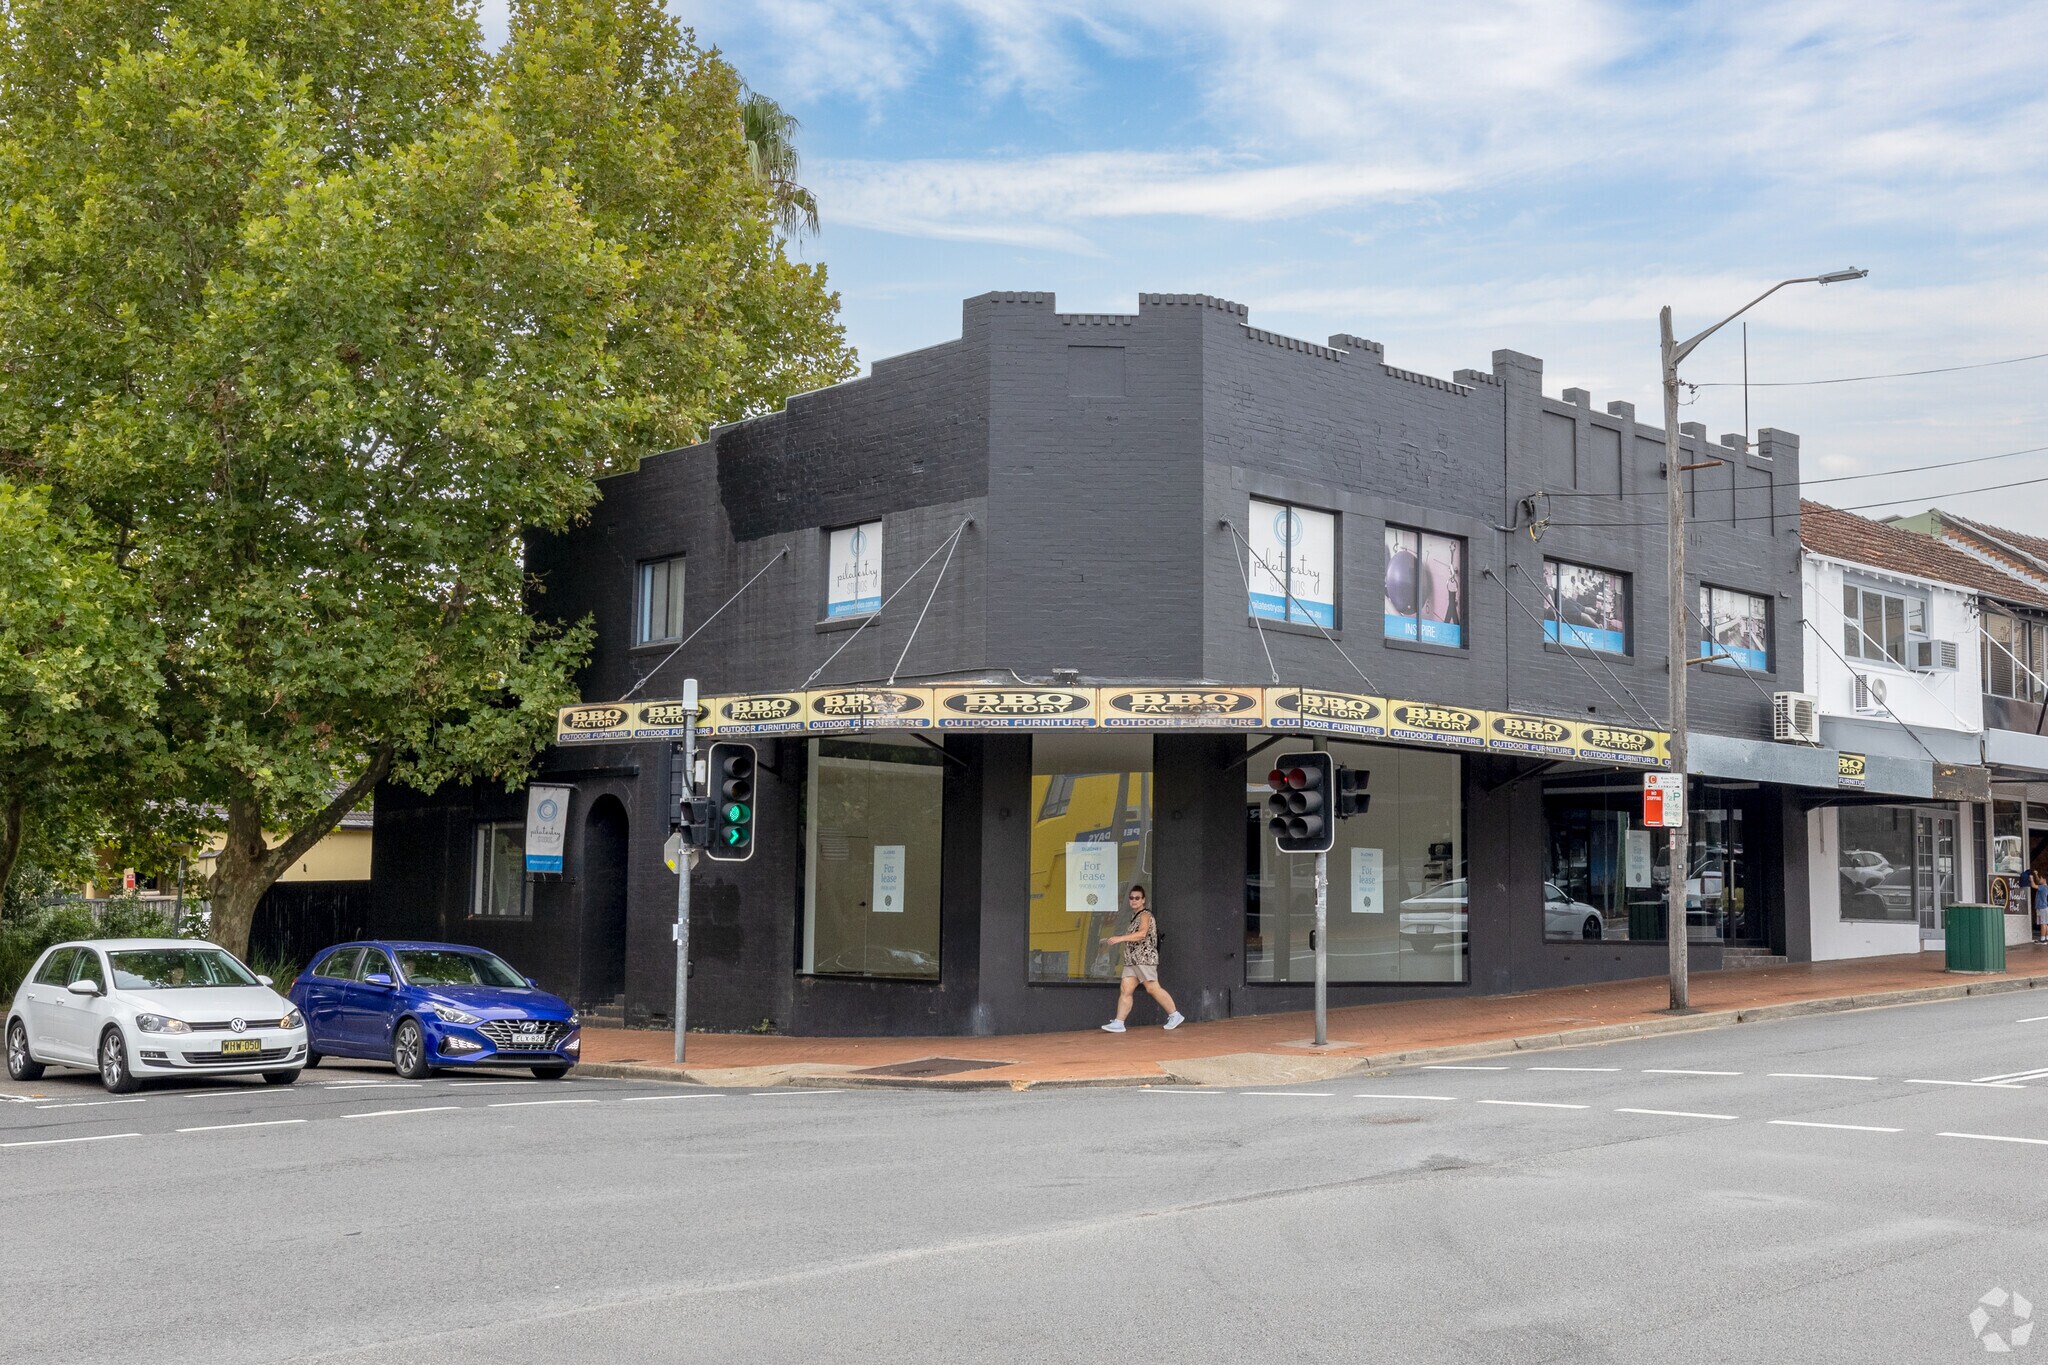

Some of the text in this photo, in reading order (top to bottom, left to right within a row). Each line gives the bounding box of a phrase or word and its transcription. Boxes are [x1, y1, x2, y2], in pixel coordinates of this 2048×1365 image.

[837, 560, 878, 587] pilatestry
[1253, 548, 1320, 595] pilatestry
[1405, 623, 1436, 637] INSPIRE
[731, 699, 792, 713] BBQ
[963, 693, 1074, 706] BBQ
[1129, 693, 1240, 706] BBQ
[1295, 694, 1371, 713] BBQ
[732, 709, 789, 720] FACTORY
[965, 704, 1069, 713] FACTORY
[1298, 705, 1369, 719] FACTORY
[571, 709, 622, 722] BBQ
[1110, 718, 1256, 726] OUTDOOR FURNITURE
[1405, 707, 1472, 724] BBQ
[571, 719, 619, 728] FACTORY
[721, 723, 801, 733] OUTDOOR FURNITURE
[812, 720, 850, 728] OUTDOOR
[944, 719, 1009, 727] OUTDOOR
[1276, 719, 1381, 735] OUTDOOR FURNITURE
[1407, 718, 1469, 731] FACTORY
[1503, 718, 1563, 735] BBQ
[1394, 729, 1481, 745] OUTDOOR FURNITURE
[1504, 729, 1561, 741] FACTORY
[1591, 729, 1647, 745] BBQ
[1492, 740, 1572, 755] OUTDOOR FURNITURE
[1592, 740, 1645, 750] FACTORY
[1582, 750, 1617, 760] OUTDOOR
[1618, 754, 1656, 764] FURNITURE
[884, 863, 895, 873] For
[1084, 861, 1101, 871] For
[1361, 865, 1373, 875] For
[881, 873, 897, 883] lease
[1079, 871, 1106, 881] lease
[1359, 875, 1376, 885] lease
[2009, 900, 2020, 912] Hut
